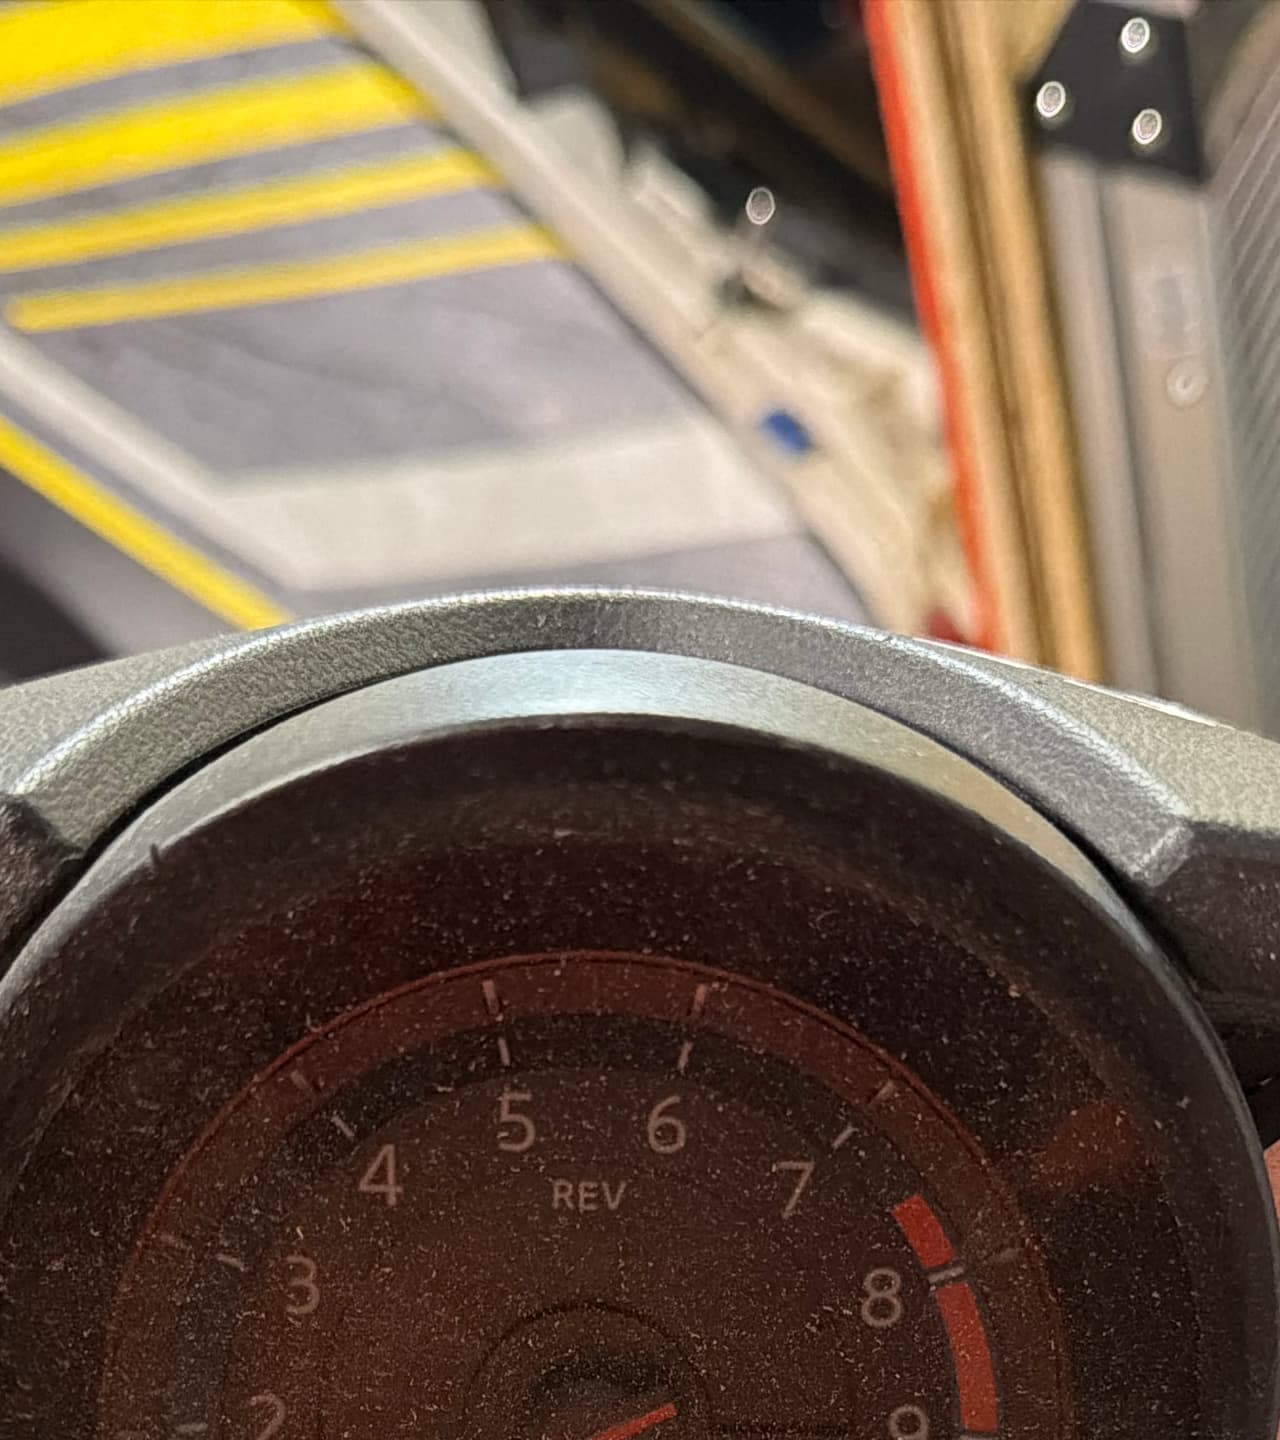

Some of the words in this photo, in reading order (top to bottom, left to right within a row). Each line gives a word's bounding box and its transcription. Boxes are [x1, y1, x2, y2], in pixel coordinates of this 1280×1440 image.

[497, 1091, 536, 1152] 5
[648, 1097, 687, 1154] 6
[358, 1143, 404, 1207] 4
[552, 1178, 627, 1212] REV
[773, 1160, 816, 1219] 7
[285, 1256, 320, 1315] 3
[861, 1267, 904, 1329] 8
